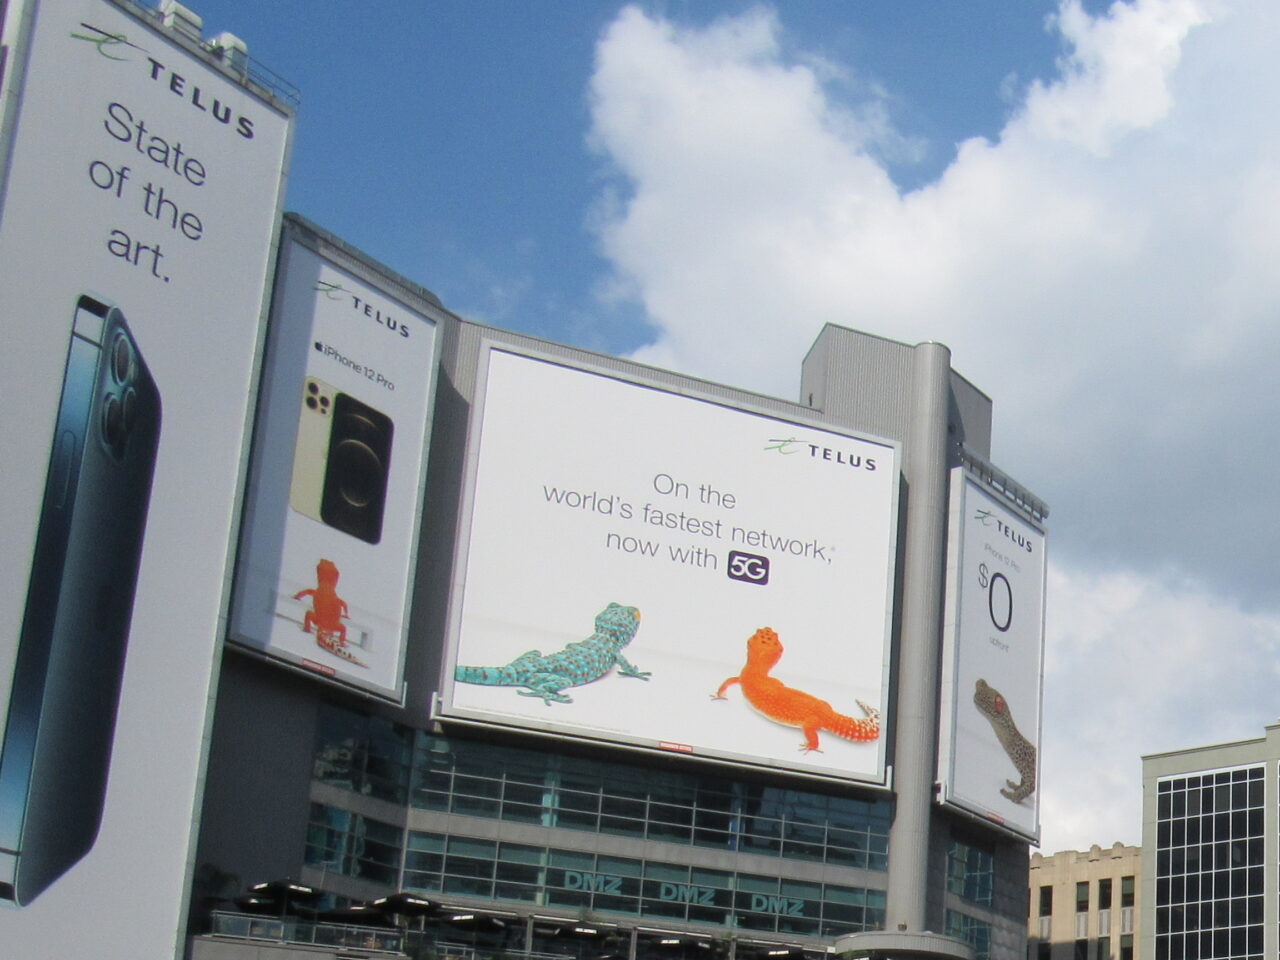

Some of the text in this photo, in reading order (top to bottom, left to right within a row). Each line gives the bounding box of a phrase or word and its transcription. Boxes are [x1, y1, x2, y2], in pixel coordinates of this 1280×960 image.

[147, 56, 255, 140] TELUS
[104, 102, 206, 187] State
[88, 160, 204, 241] of the
[107, 228, 170, 283] art.
[352, 295, 410, 338] TELUS
[323, 344, 395, 391] iPhone 12 Pro
[808, 443, 877, 471] TELUS
[543, 484, 634, 520] world's
[643, 502, 723, 540] fastest
[653, 473, 736, 510] On the
[605, 531, 766, 580] now with 5G
[997, 519, 1033, 553] TELUS
[564, 870, 623, 895] DMZ
[659, 882, 716, 906] DMZ
[751, 894, 804, 917] DMZ
